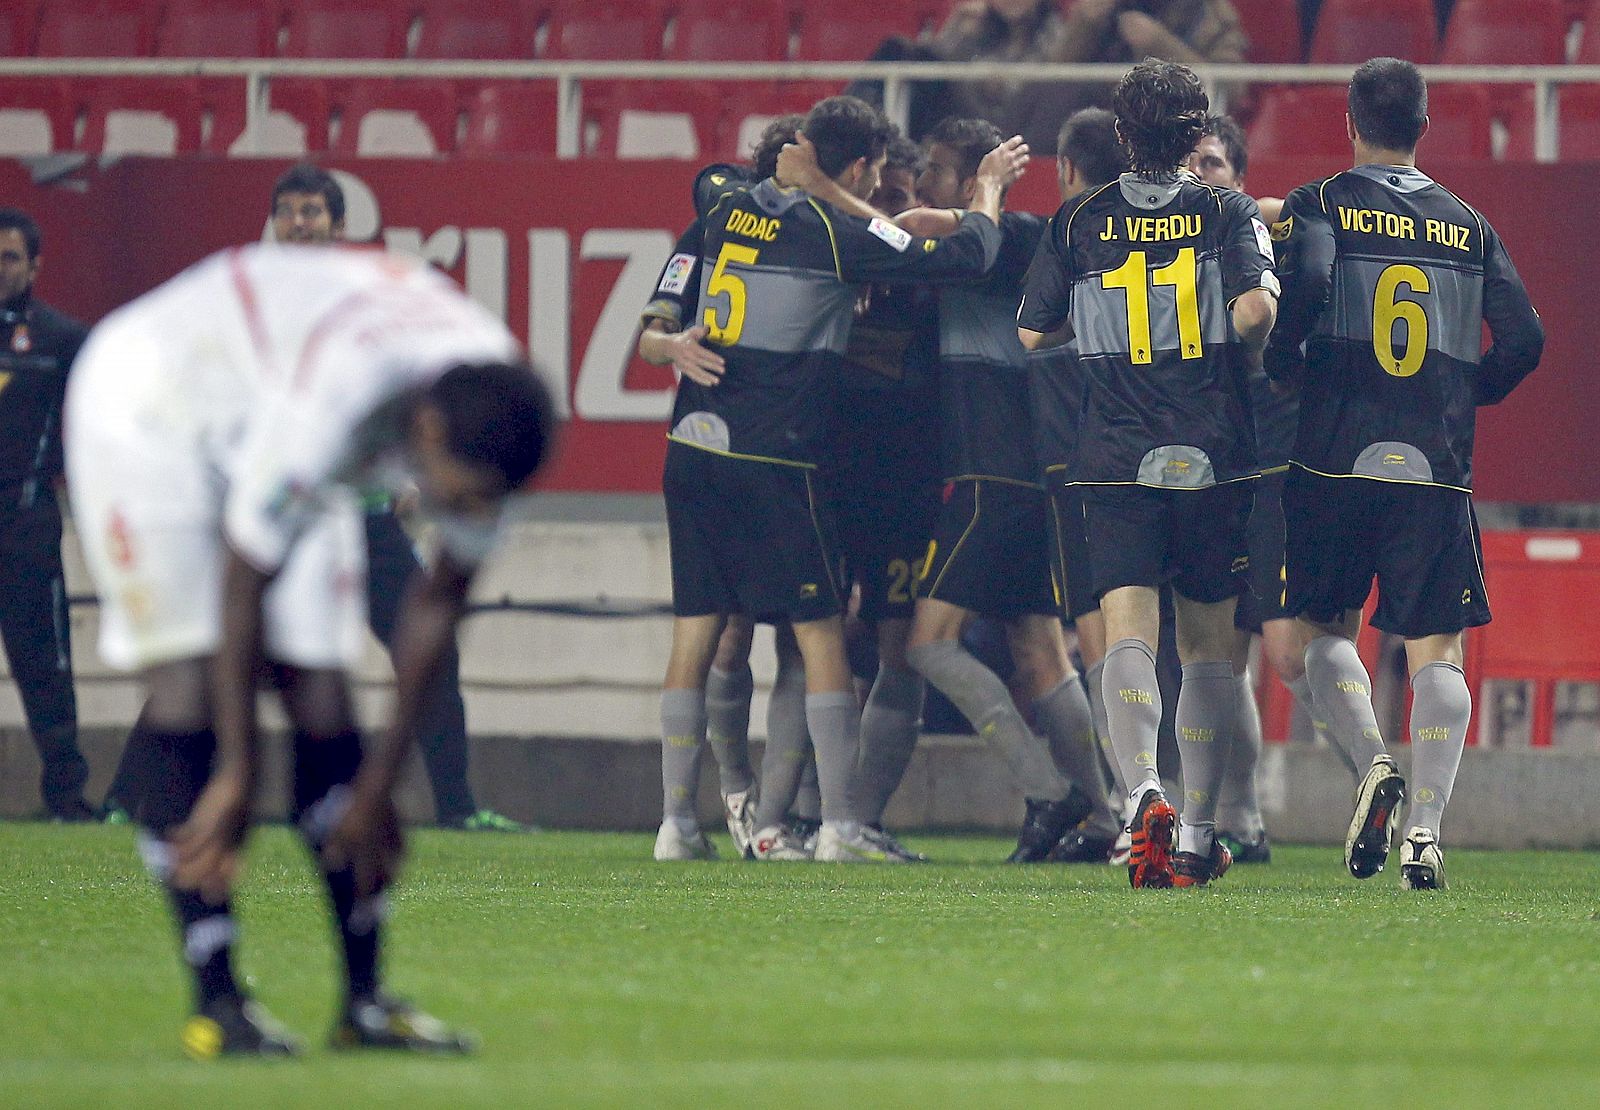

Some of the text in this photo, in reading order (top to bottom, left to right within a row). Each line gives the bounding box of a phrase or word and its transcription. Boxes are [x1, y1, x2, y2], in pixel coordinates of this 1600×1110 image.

[725, 208, 782, 242] DIDAC
[1099, 214, 1202, 242] J. VERDU
[1337, 205, 1471, 252] VICTOR RUIZ
[703, 241, 760, 347] 5
[1101, 247, 1203, 364] 11
[1372, 263, 1430, 378] 6
